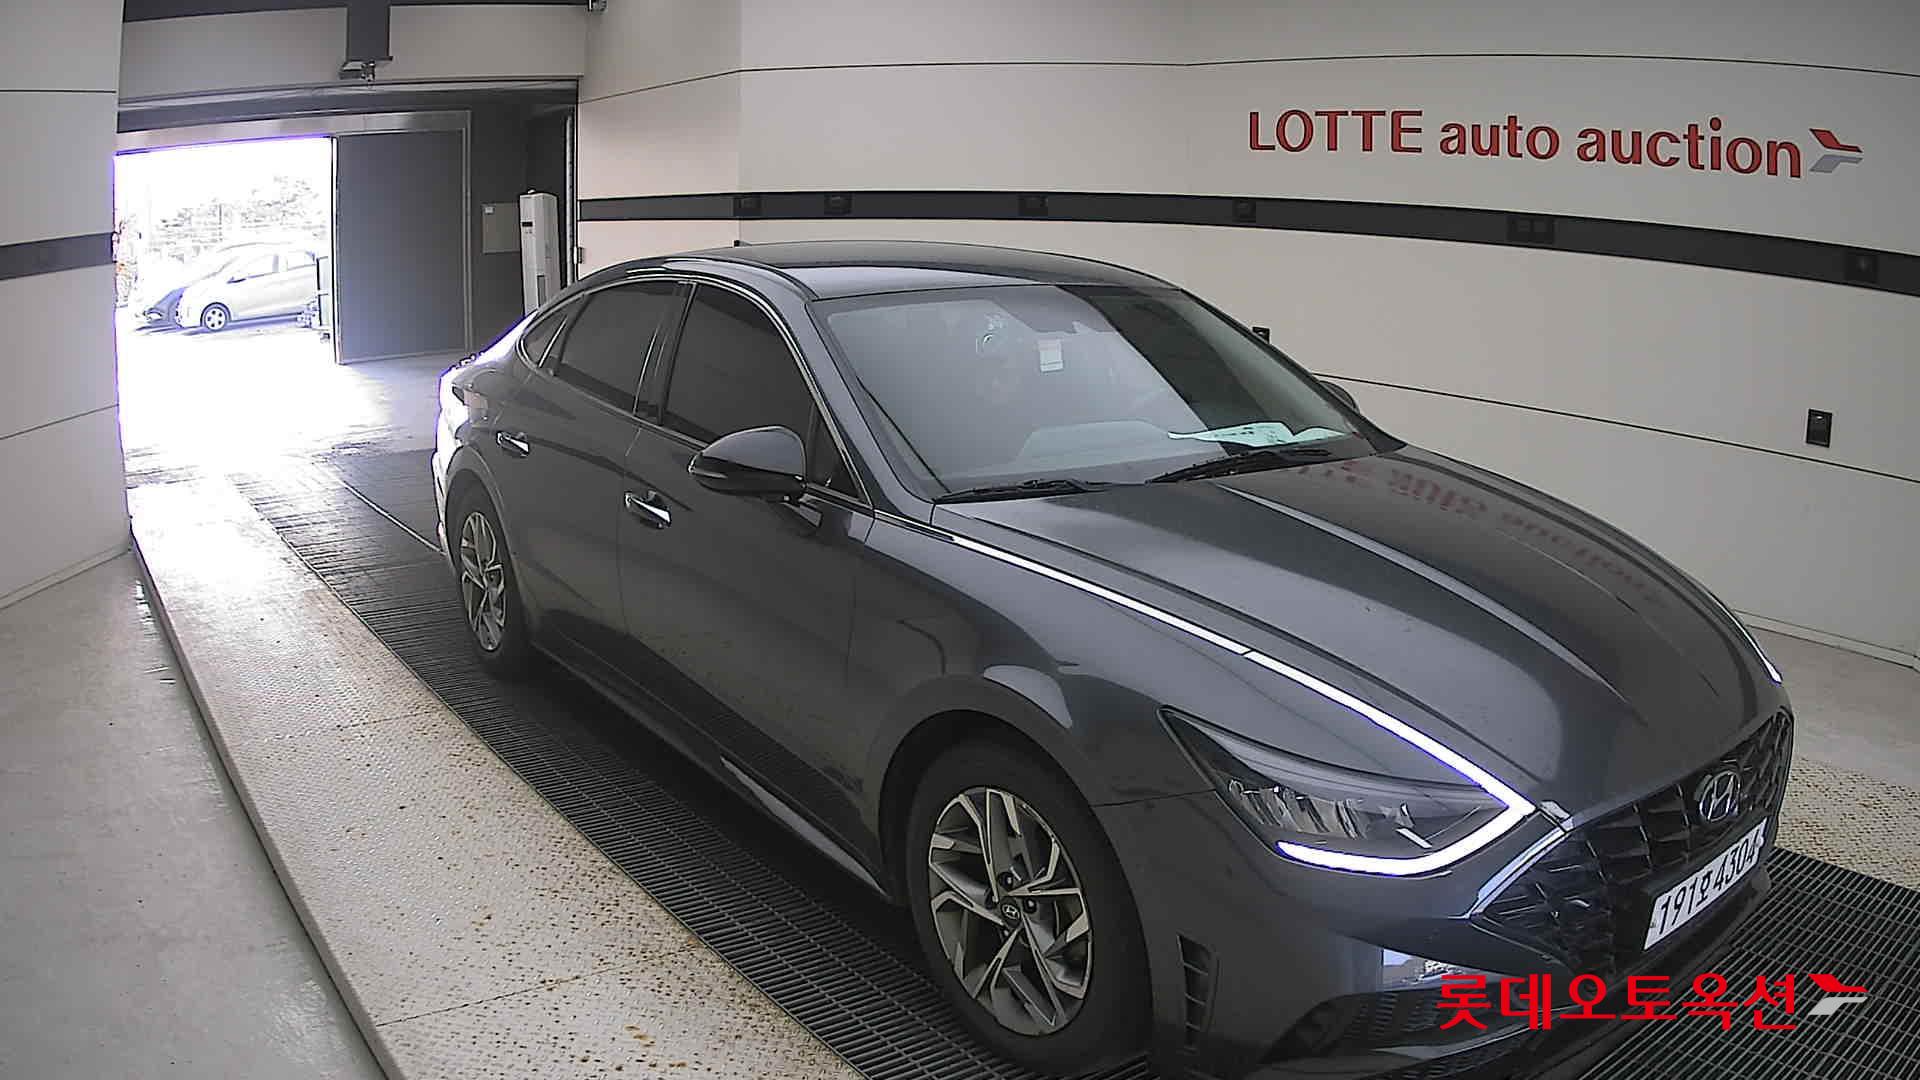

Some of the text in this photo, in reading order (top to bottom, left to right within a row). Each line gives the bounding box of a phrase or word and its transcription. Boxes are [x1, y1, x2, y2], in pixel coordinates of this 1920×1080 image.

[1249, 109, 1802, 179] LOTTE auto auction
